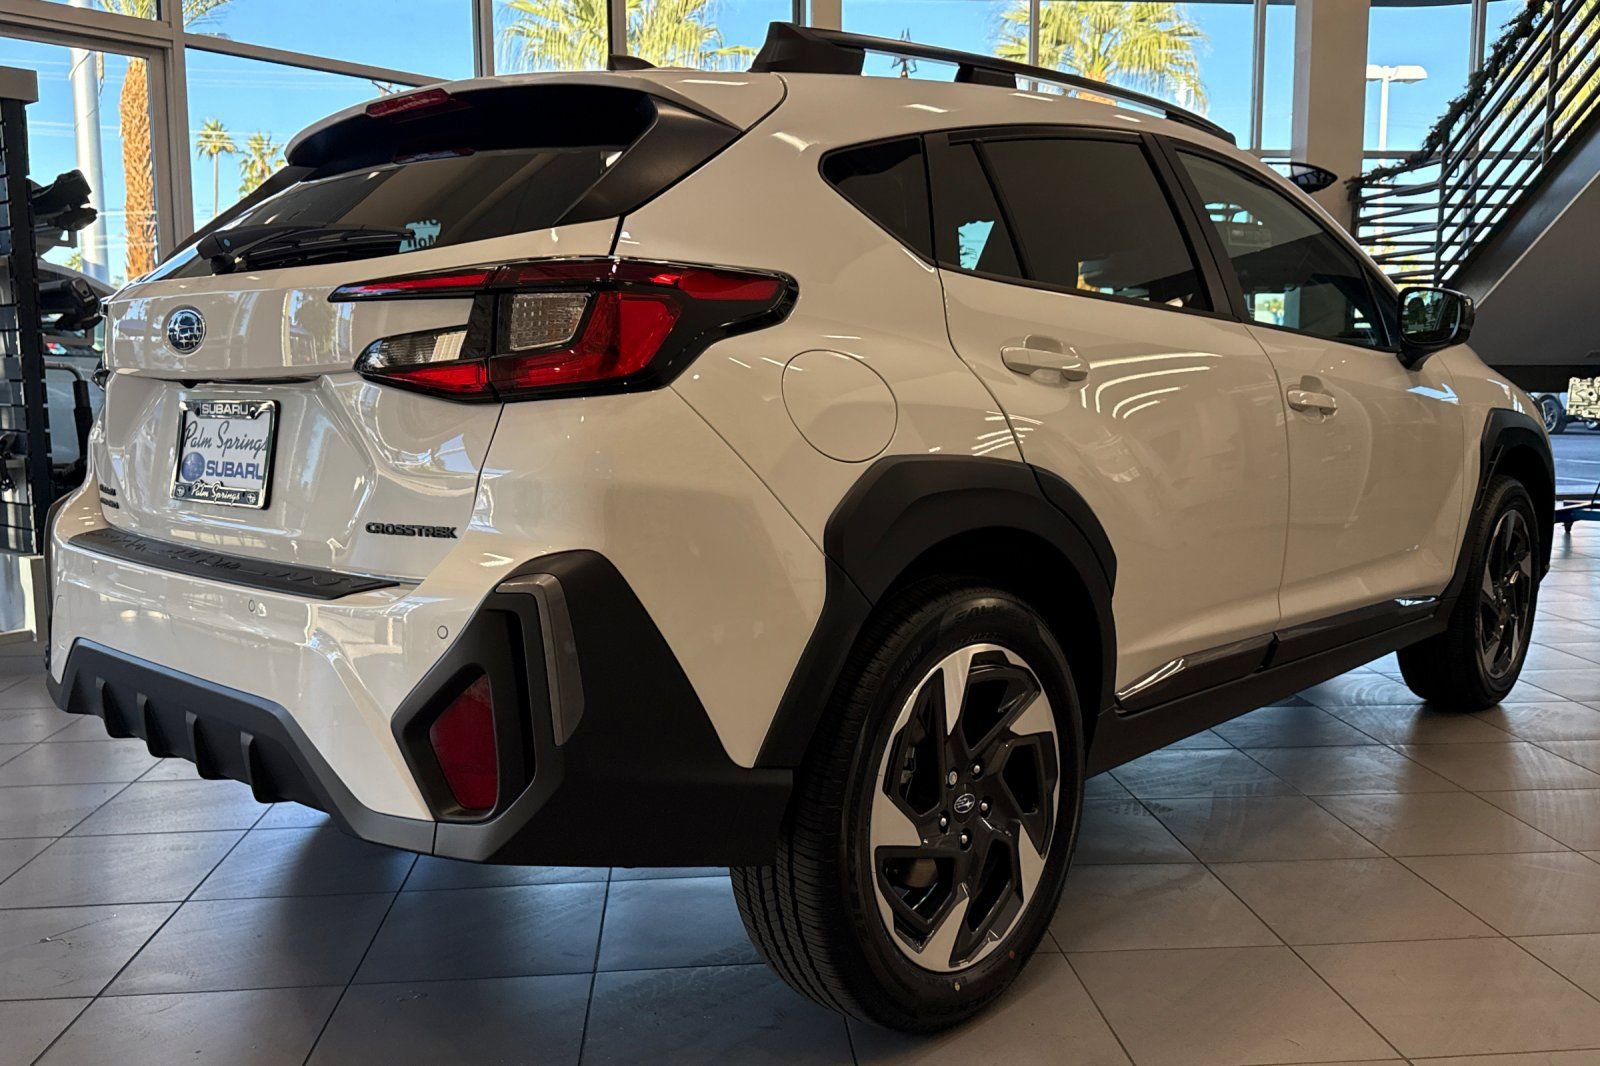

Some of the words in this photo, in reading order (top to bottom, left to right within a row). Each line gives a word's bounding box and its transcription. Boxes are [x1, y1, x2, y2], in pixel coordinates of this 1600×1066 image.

[202, 403, 248, 415] SUBARU
[183, 420, 213, 448] Palm
[216, 420, 267, 459] Springs
[191, 481, 209, 498] Palm
[211, 482, 240, 506] Springs
[365, 522, 458, 539] CROSSTREK
